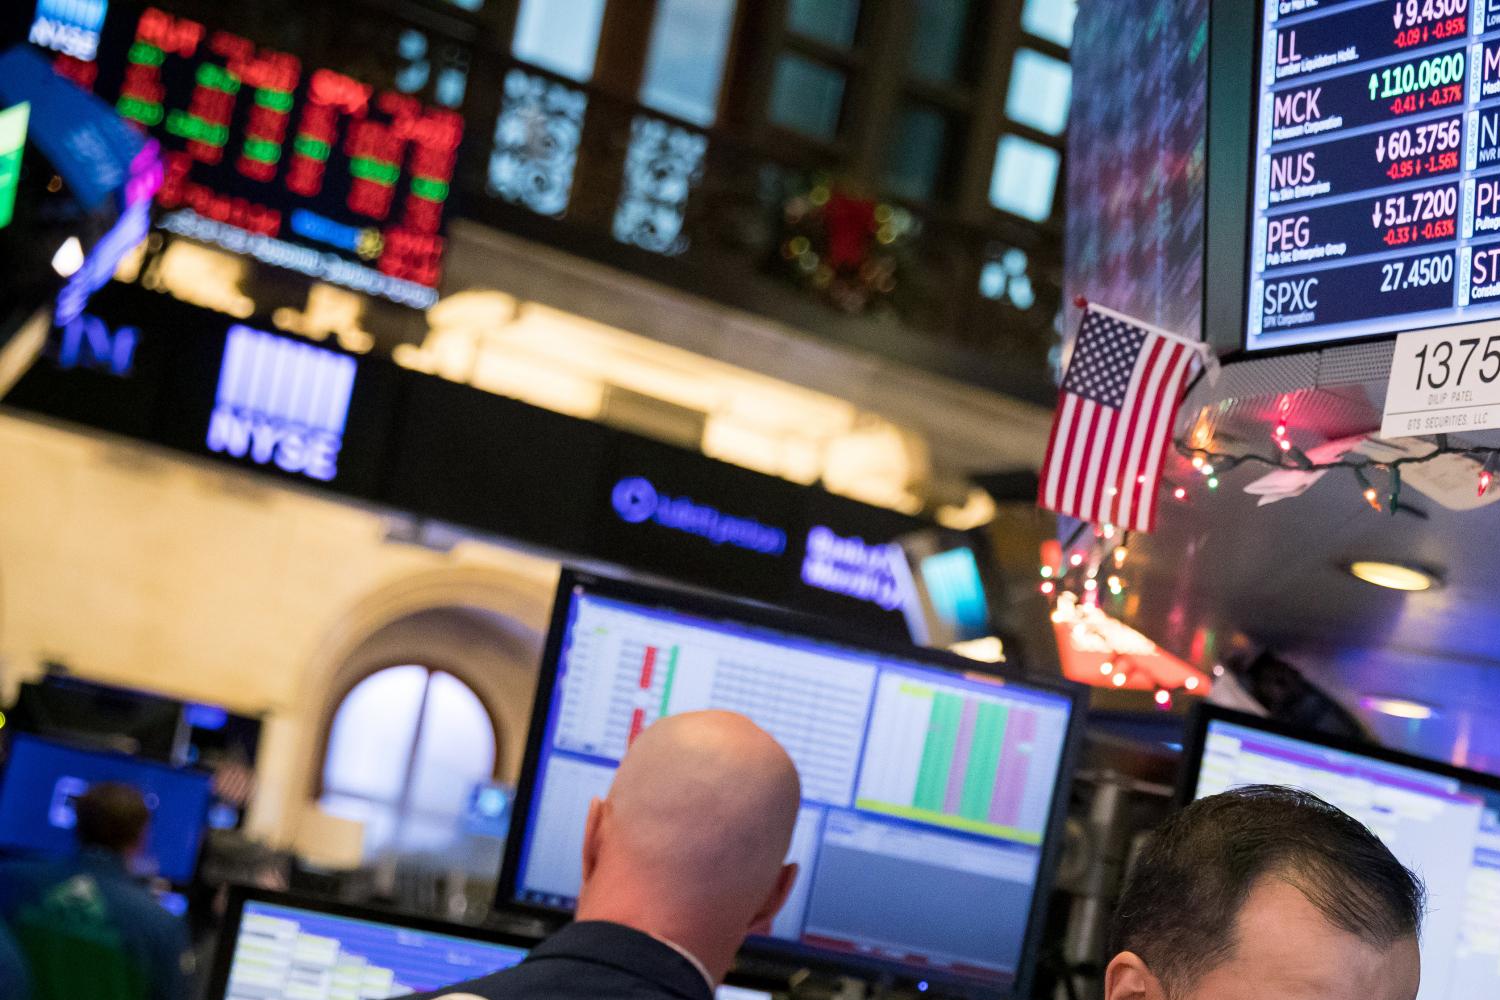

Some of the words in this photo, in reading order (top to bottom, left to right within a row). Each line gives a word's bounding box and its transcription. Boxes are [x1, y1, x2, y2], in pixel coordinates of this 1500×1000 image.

[1432, 17, 1465, 39] -0.95%
[1277, 31, 1301, 65] LL
[1381, 52, 1464, 99] 110.0600
[1274, 87, 1322, 127] MCK
[1388, 119, 1461, 160] 60.3756
[1479, 148, 1497, 163] NVR
[1271, 152, 1316, 190] NUS
[1386, 163, 1413, 180] -0.95
[1384, 187, 1457, 226] 51.7200
[1267, 216, 1310, 252] PEG
[1380, 254, 1453, 293] 27.4500
[1264, 278, 1319, 315] SPXC
[1451, 390, 1473, 402] PATEL
[1473, 412, 1488, 425] LLC
[206, 405, 341, 481] NYSE
